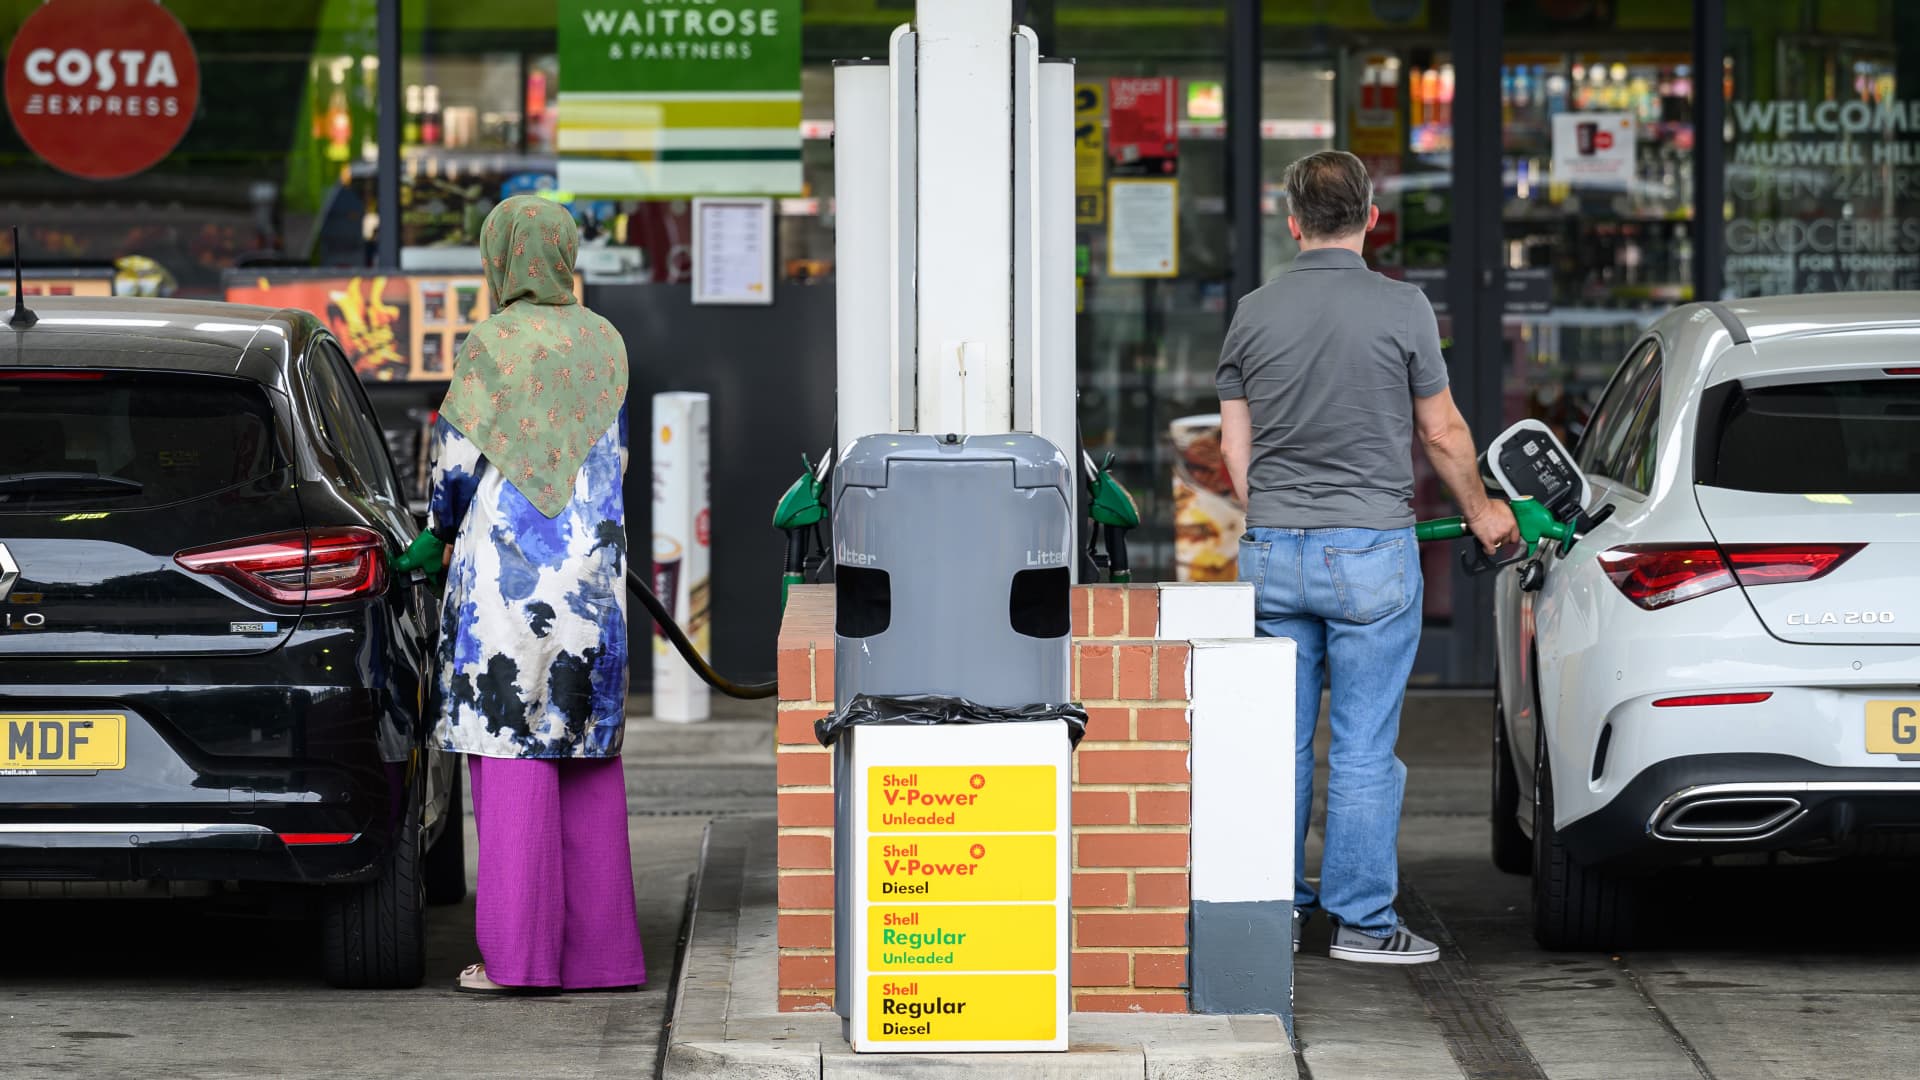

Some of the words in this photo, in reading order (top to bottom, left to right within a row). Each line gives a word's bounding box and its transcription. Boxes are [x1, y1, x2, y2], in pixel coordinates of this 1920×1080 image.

[582, 8, 779, 36] WAITROSE
[608, 42, 623, 60] &
[630, 41, 752, 60] PARTNERS
[25, 48, 178, 91] COSTA
[49, 94, 179, 116] EXPRESS
[1734, 141, 1866, 164] MUSWELL
[1729, 168, 1825, 200] OPEN
[1725, 217, 1920, 252] GROCERIES
[1800, 254, 1834, 271] FOR
[1026, 549, 1068, 566] Litter
[1787, 612, 1838, 625] CLA
[1844, 611, 1895, 624] 200
[1892, 707, 1917, 744] G
[8, 721, 94, 760] MDF
[883, 774, 918, 787] Shell
[884, 789, 978, 806] V-Power
[882, 812, 955, 825] Unleaded
[883, 844, 918, 857] Shell
[884, 859, 978, 876] V-Power
[882, 881, 929, 894] Diesel
[883, 912, 919, 926] Shell
[883, 928, 966, 949] Regular
[883, 952, 954, 964] Unleaded
[882, 983, 918, 996] Shell
[883, 997, 966, 1018] Regular
[883, 1022, 931, 1035] Diesel
